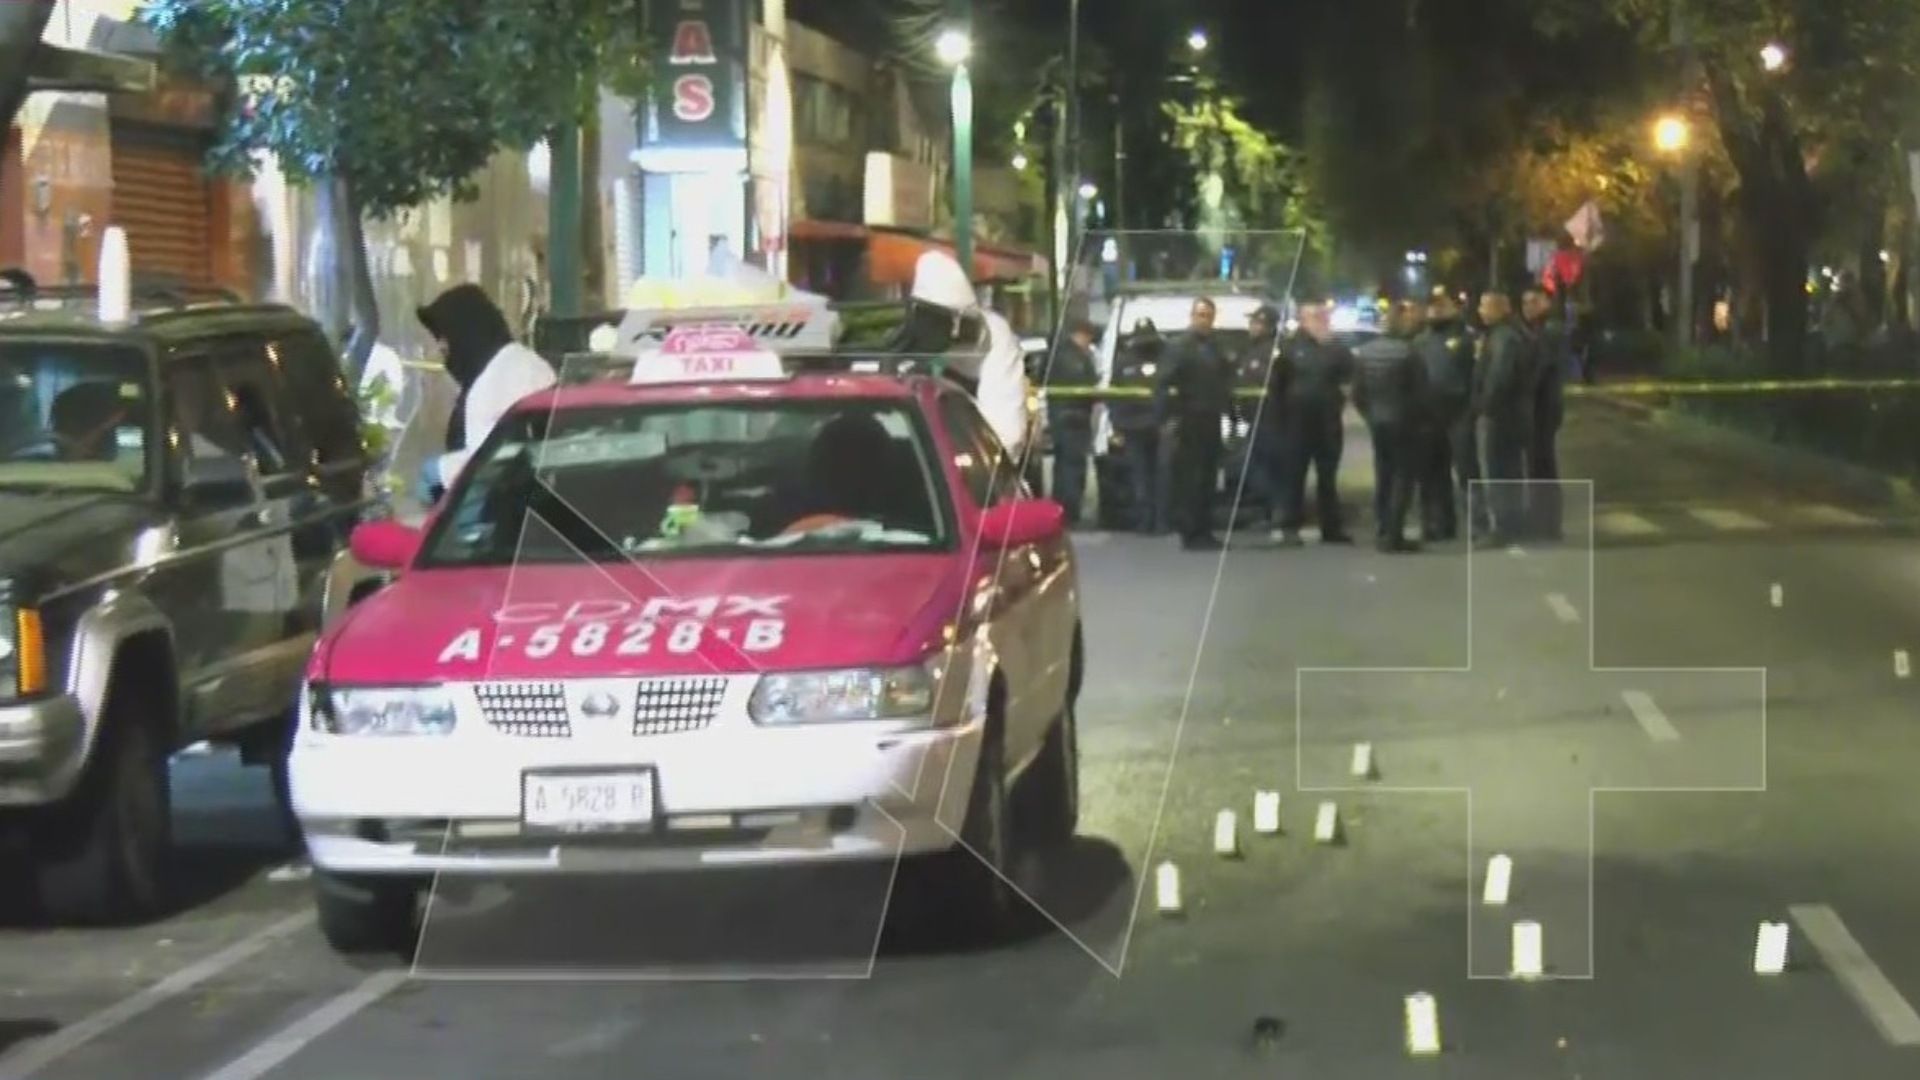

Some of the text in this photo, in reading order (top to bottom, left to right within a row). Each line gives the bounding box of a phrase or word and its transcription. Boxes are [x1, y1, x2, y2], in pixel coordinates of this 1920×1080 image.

[668, 0, 718, 121] AS
[681, 356, 735, 374] TAXI
[492, 594, 792, 624] CDMX
